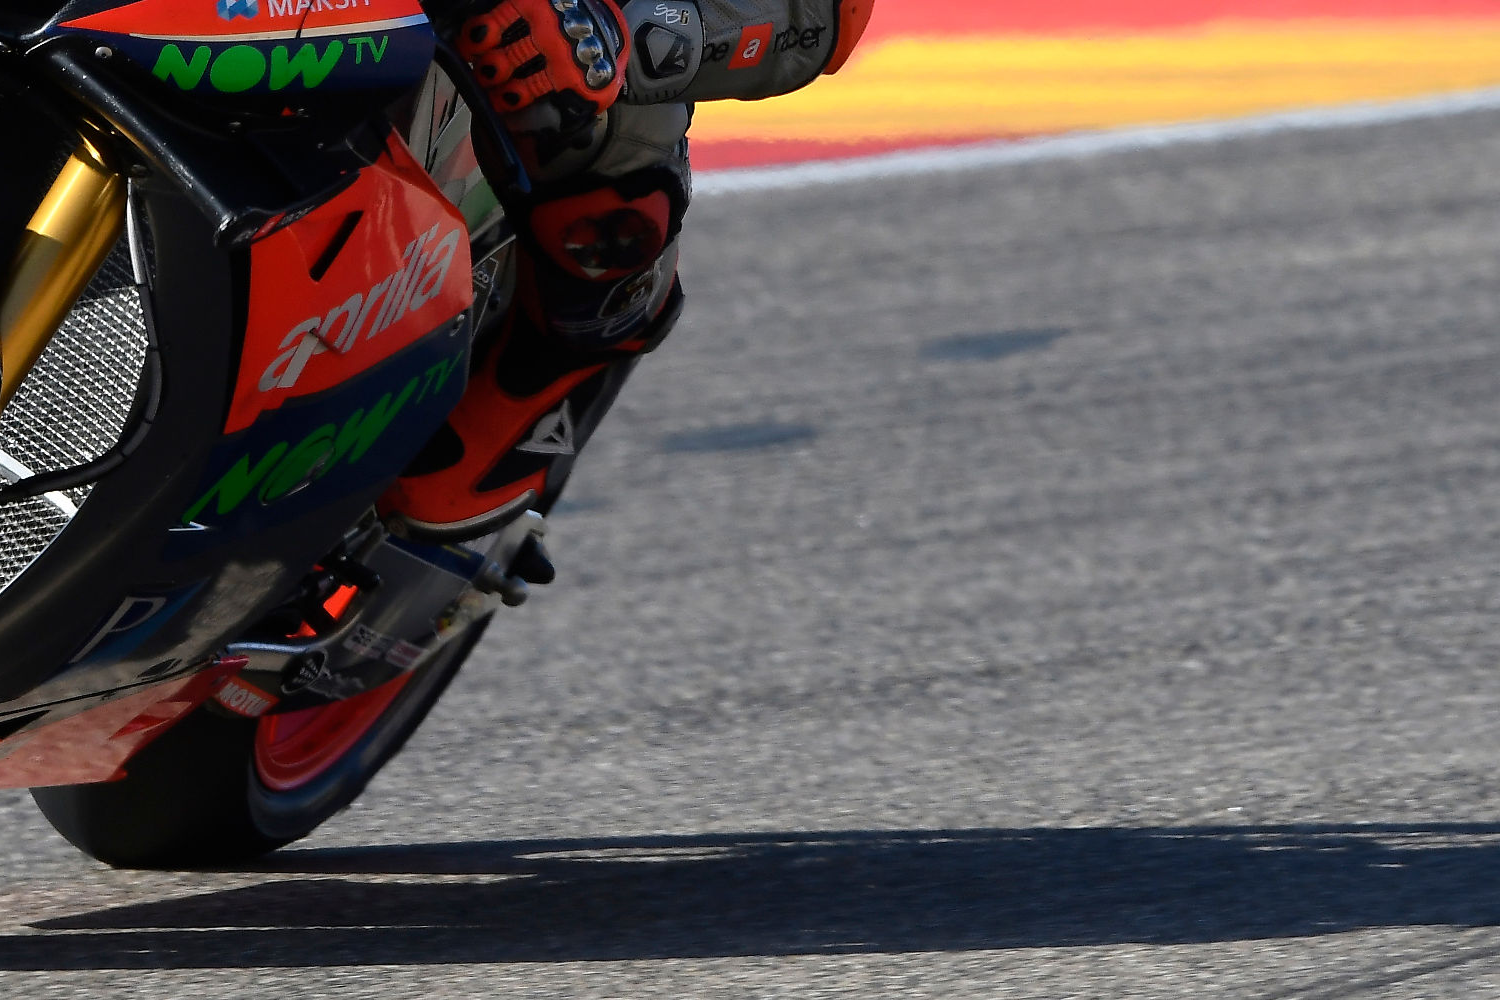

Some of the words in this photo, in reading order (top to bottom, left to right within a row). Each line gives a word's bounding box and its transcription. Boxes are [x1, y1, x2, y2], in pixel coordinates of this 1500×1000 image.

[152, 39, 344, 93] NOW
[347, 35, 390, 65] TV
[257, 222, 460, 392] aprilia
[182, 376, 420, 525] NOW
